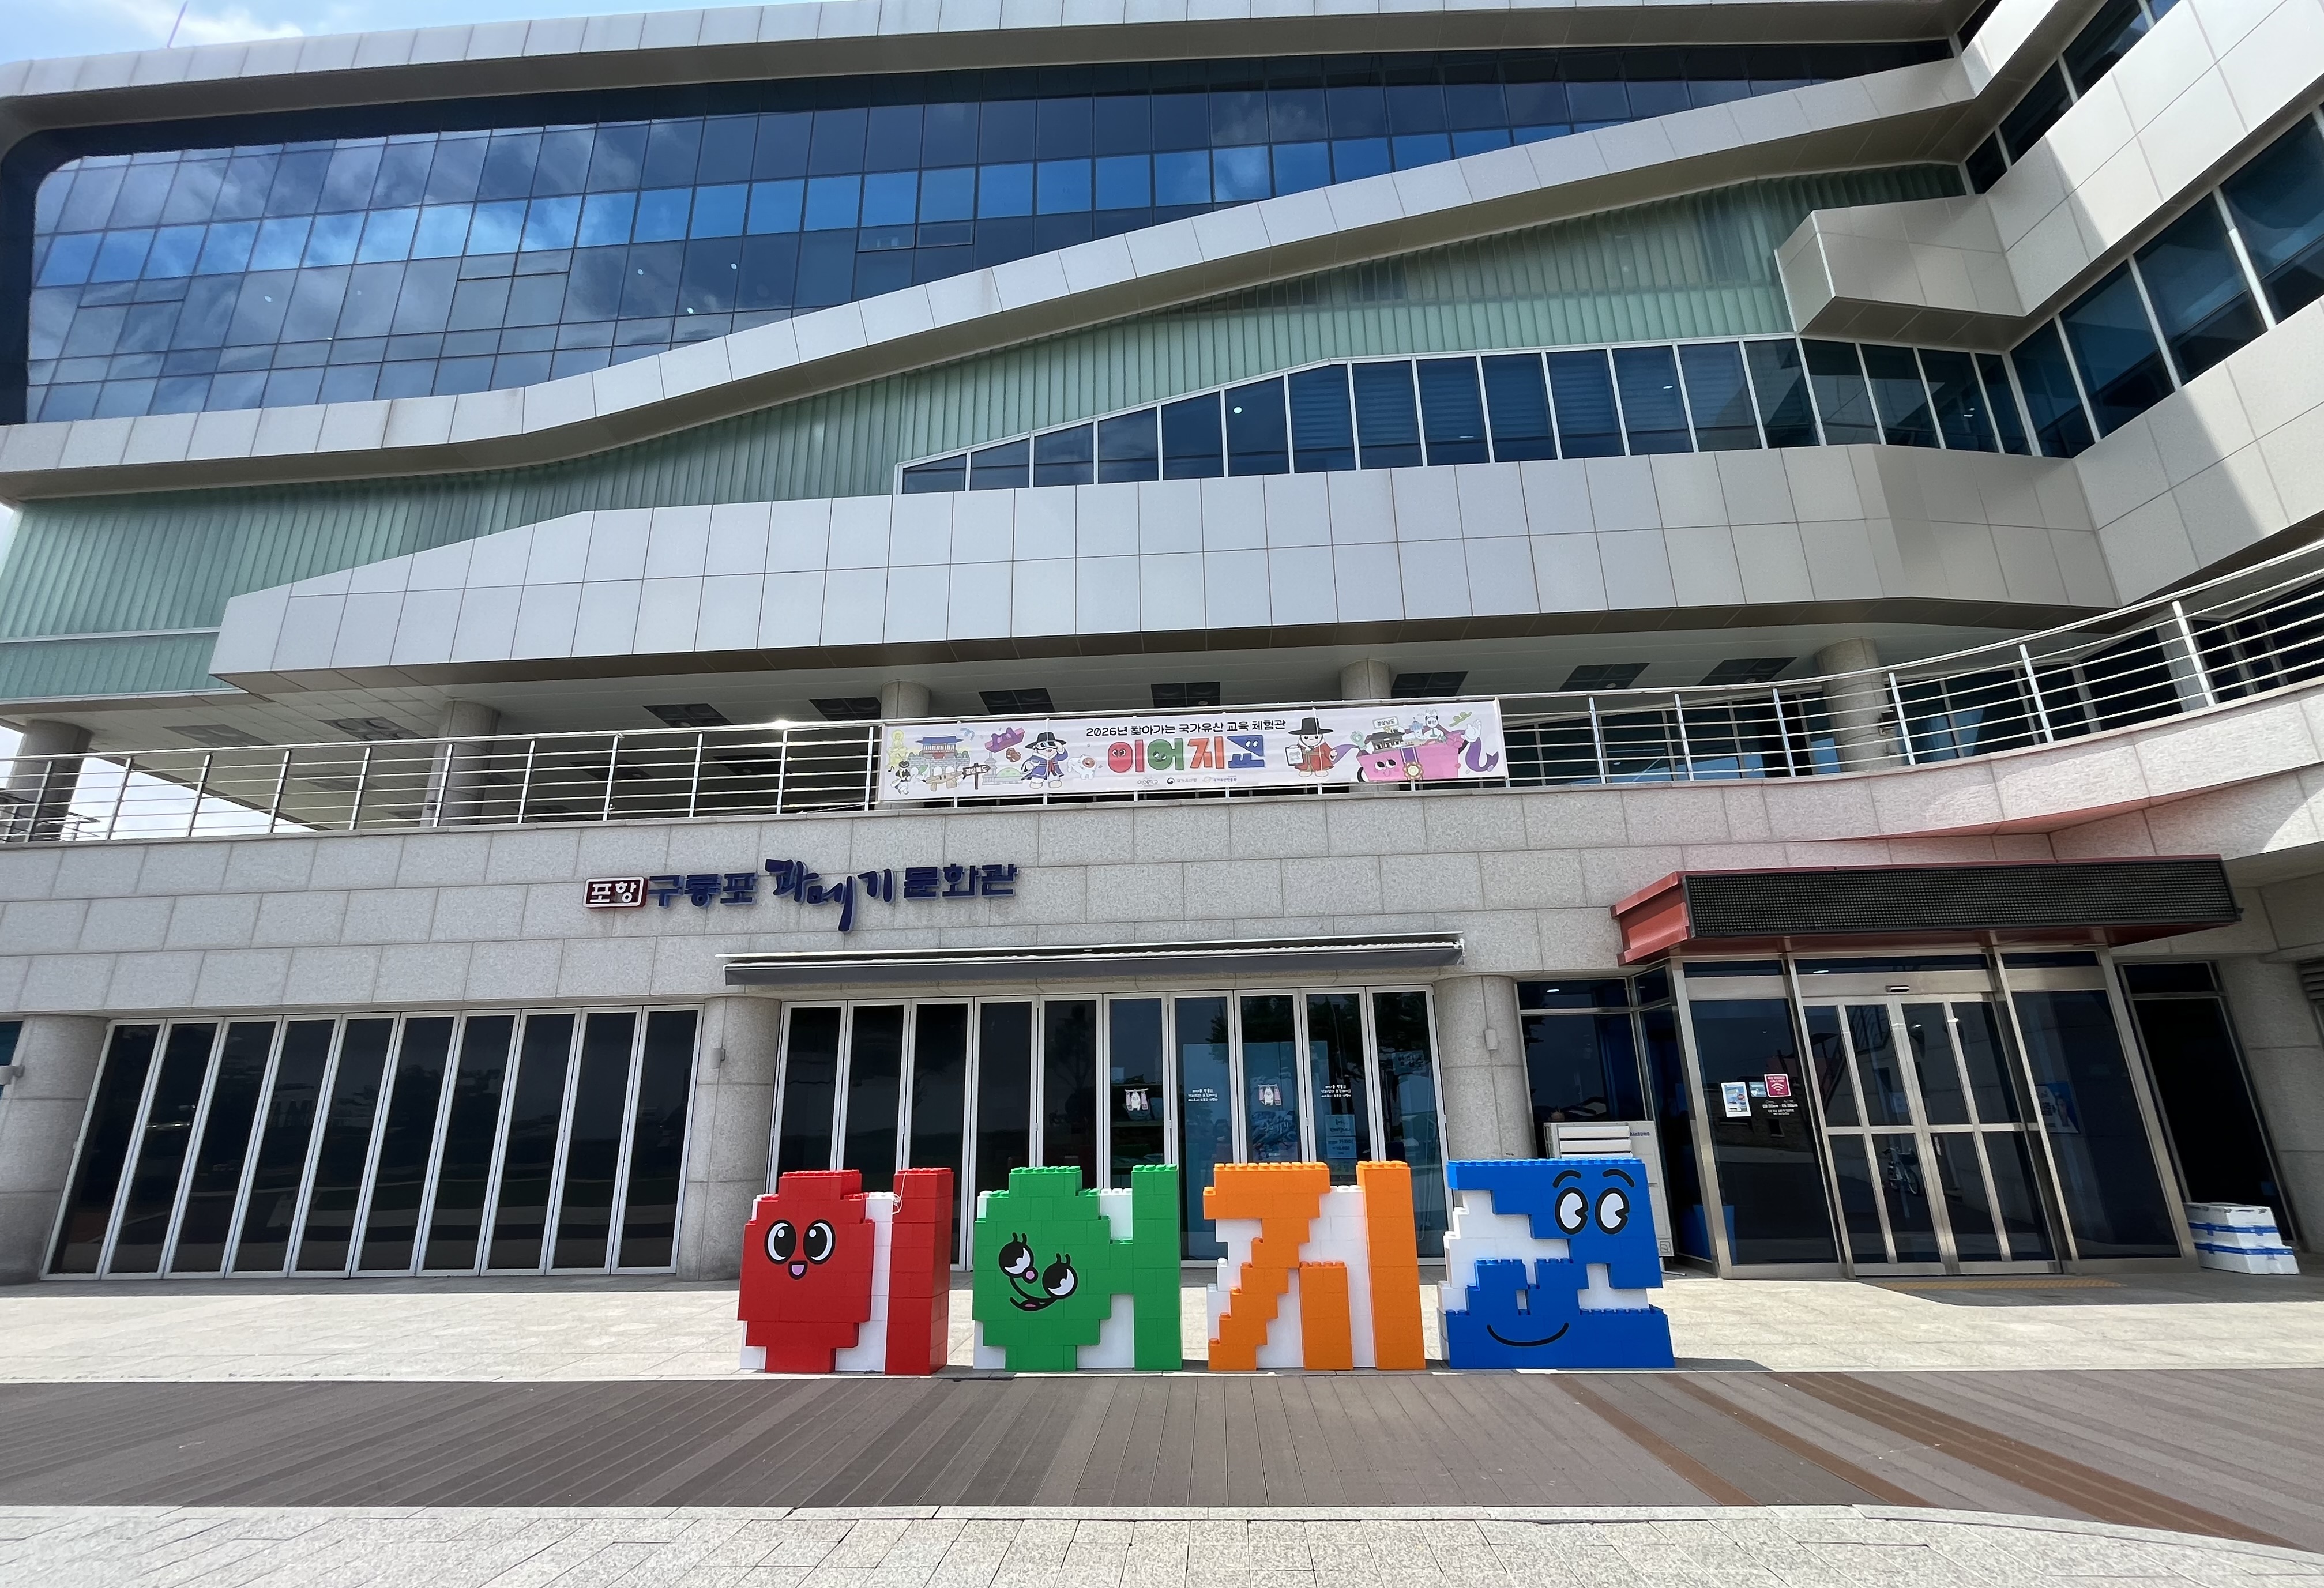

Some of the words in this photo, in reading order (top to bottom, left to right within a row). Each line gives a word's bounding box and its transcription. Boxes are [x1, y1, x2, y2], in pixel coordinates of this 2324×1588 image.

[1086, 726, 1128, 736] 2026년
[1131, 724, 1176, 736] 찾아가는
[1179, 722, 1224, 733] 국가유산
[1227, 721, 1249, 732] 교육
[1252, 720, 1286, 731] 체험관
[1107, 735, 1265, 773] 이어지교
[965, 766, 987, 774] 경상북도
[589, 880, 638, 905] 포항
[649, 872, 759, 908] 구룡포
[765, 858, 894, 932] 과메기
[903, 863, 1018, 900] 문화관
